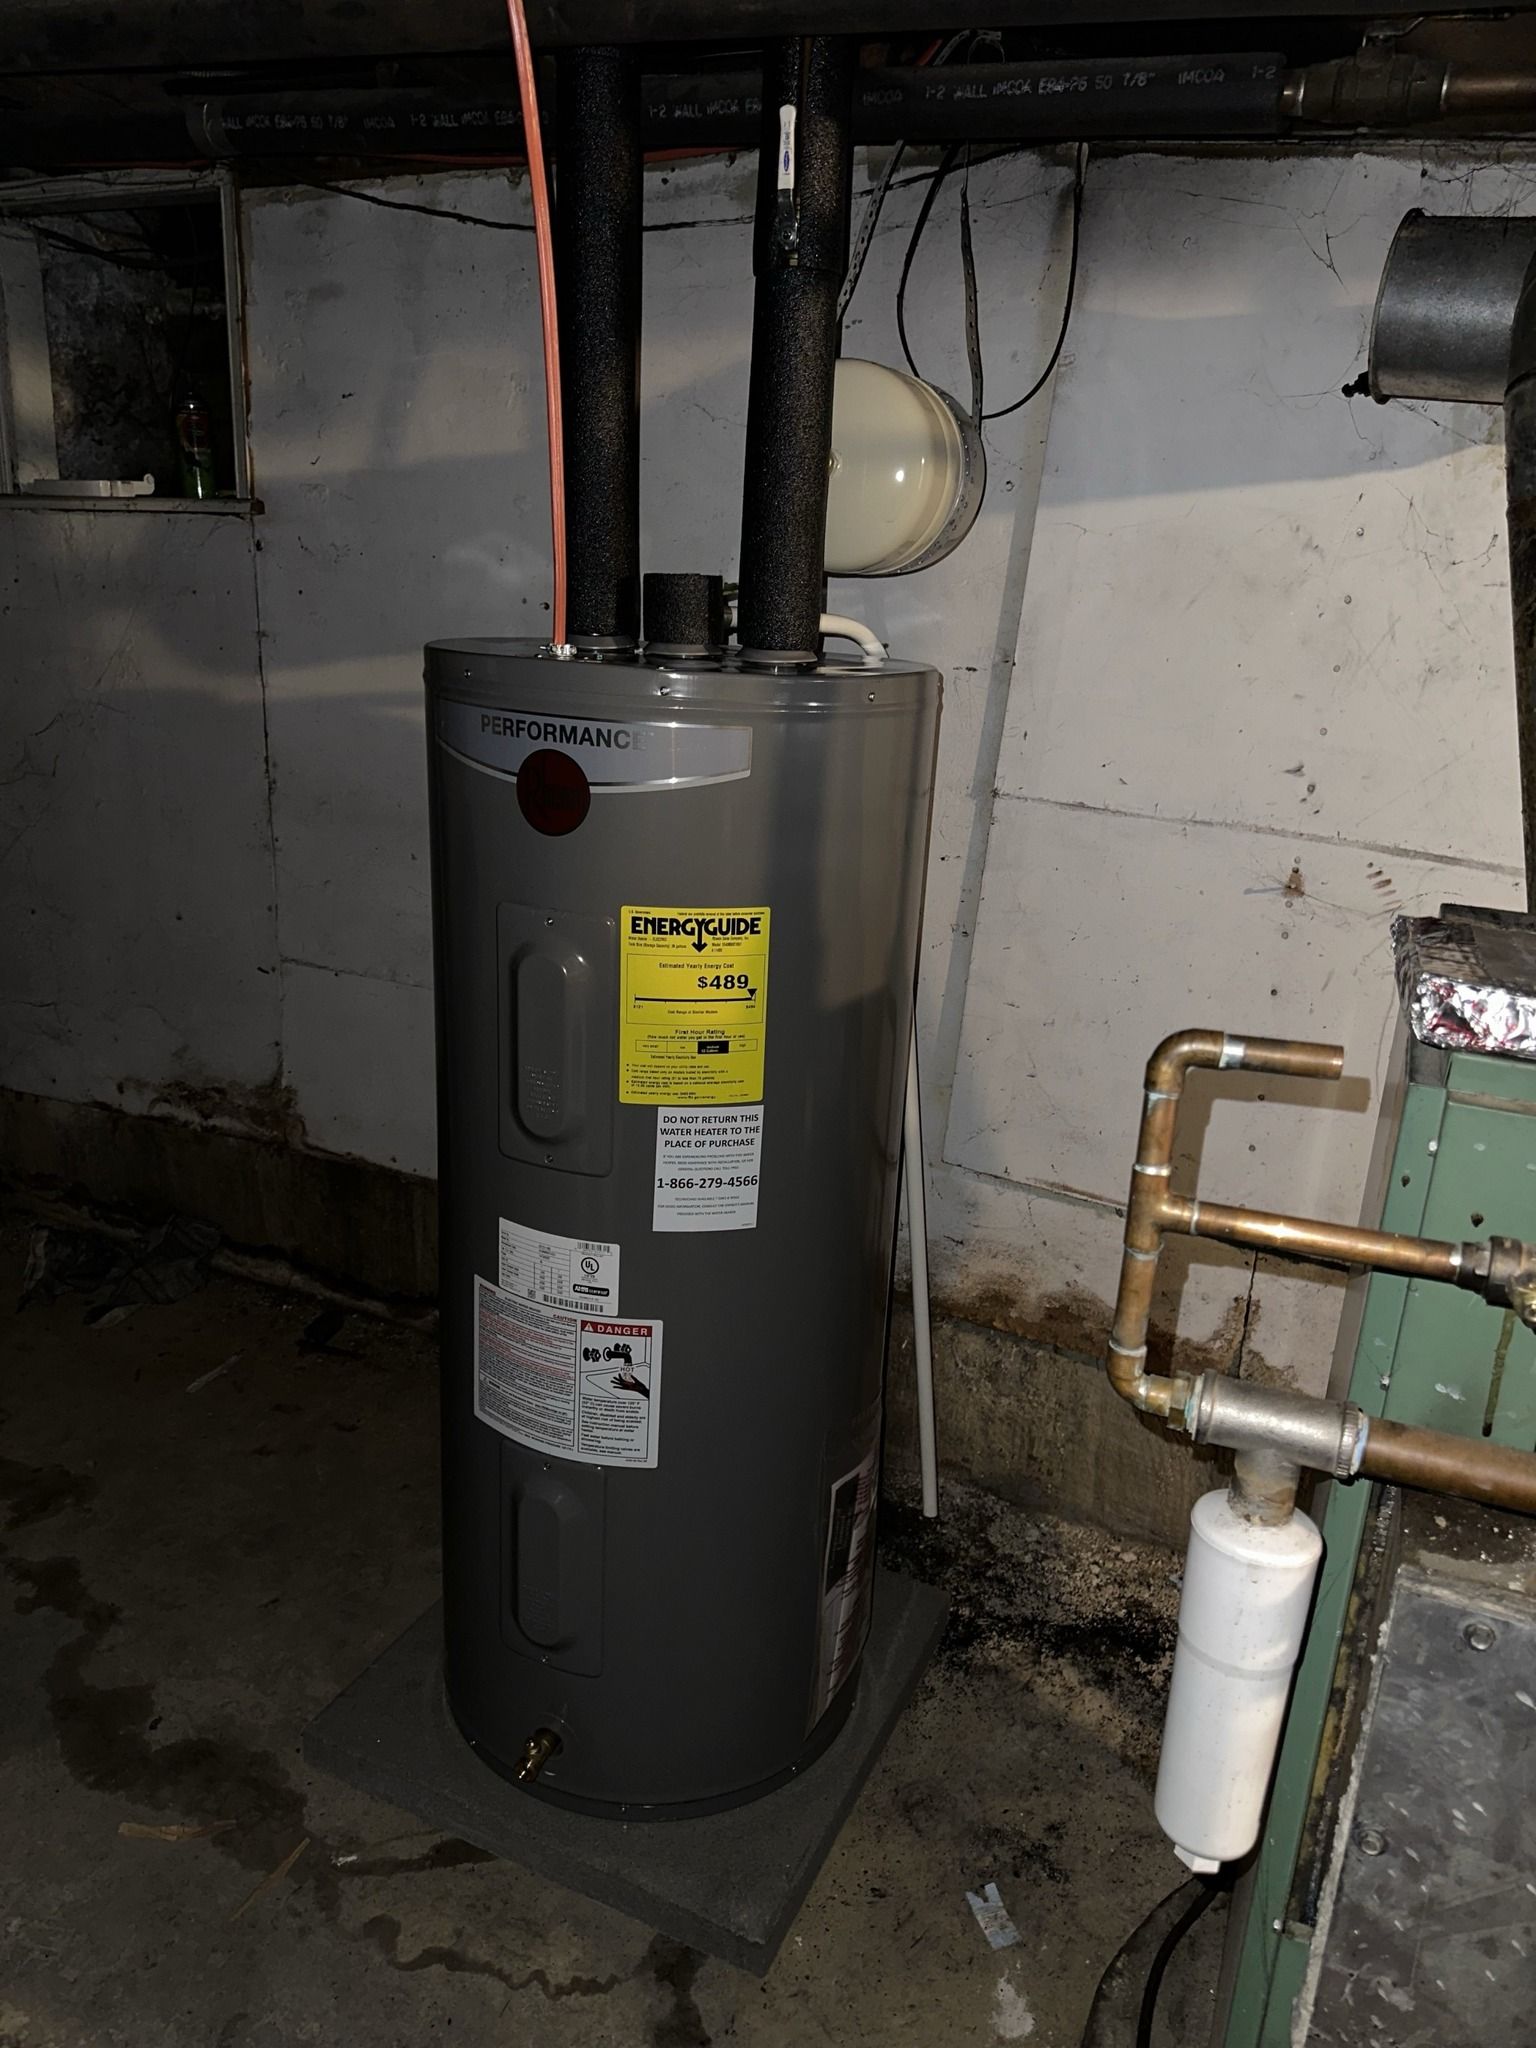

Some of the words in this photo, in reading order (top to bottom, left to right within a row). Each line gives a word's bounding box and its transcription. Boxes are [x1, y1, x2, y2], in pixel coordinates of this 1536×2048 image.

[953, 84, 987, 101] WALL
[1095, 75, 1112, 89] 50
[1178, 68, 1225, 84] IMCOA
[1251, 65, 1277, 79] 1-2
[631, 916, 761, 936] ENERGYGUIDE
[698, 975, 749, 990] $489
[680, 1116, 699, 1124] NOT
[702, 1115, 737, 1123] RETURN
[740, 1114, 759, 1122] THIS
[664, 1140, 692, 1148] PLACE
[709, 1138, 755, 1147] PURCHASE
[657, 1175, 758, 1189] 1-866-279-4566
[597, 1324, 648, 1336] DANGER
